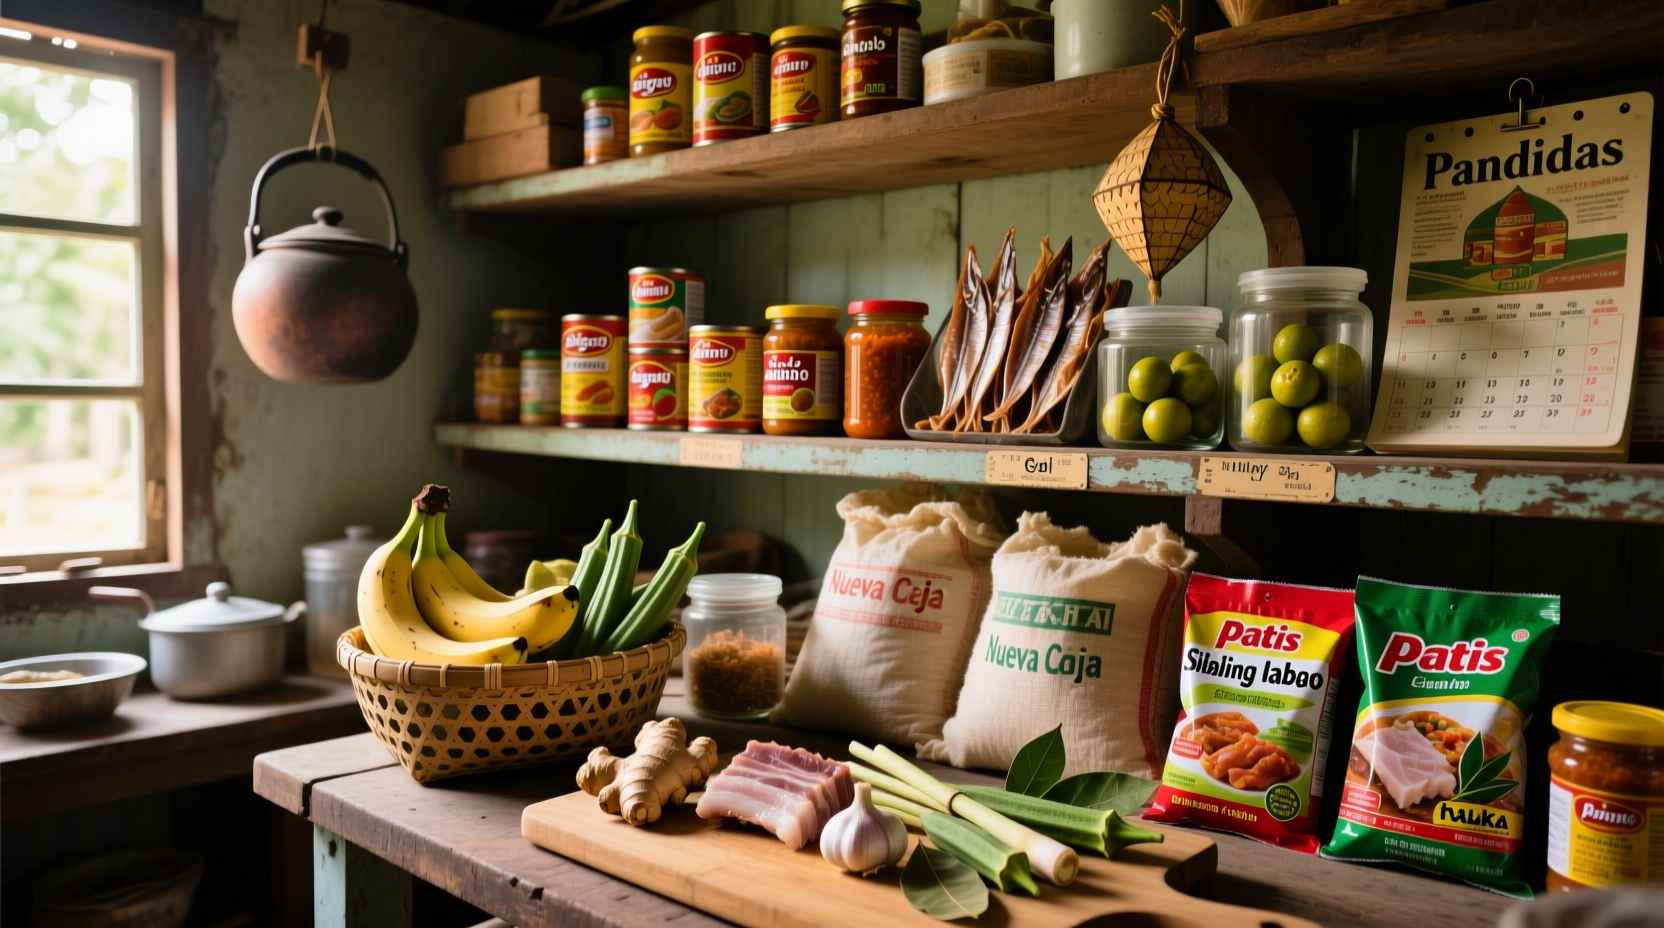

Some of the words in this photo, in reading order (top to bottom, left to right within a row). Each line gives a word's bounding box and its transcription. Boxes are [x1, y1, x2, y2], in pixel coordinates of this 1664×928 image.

[1423, 133, 1624, 190] Pandidas
[829, 569, 885, 600] Nueva
[985, 634, 1039, 673] Nueva
[1215, 620, 1302, 652] Patis
[1376, 633, 1508, 674] Patis
